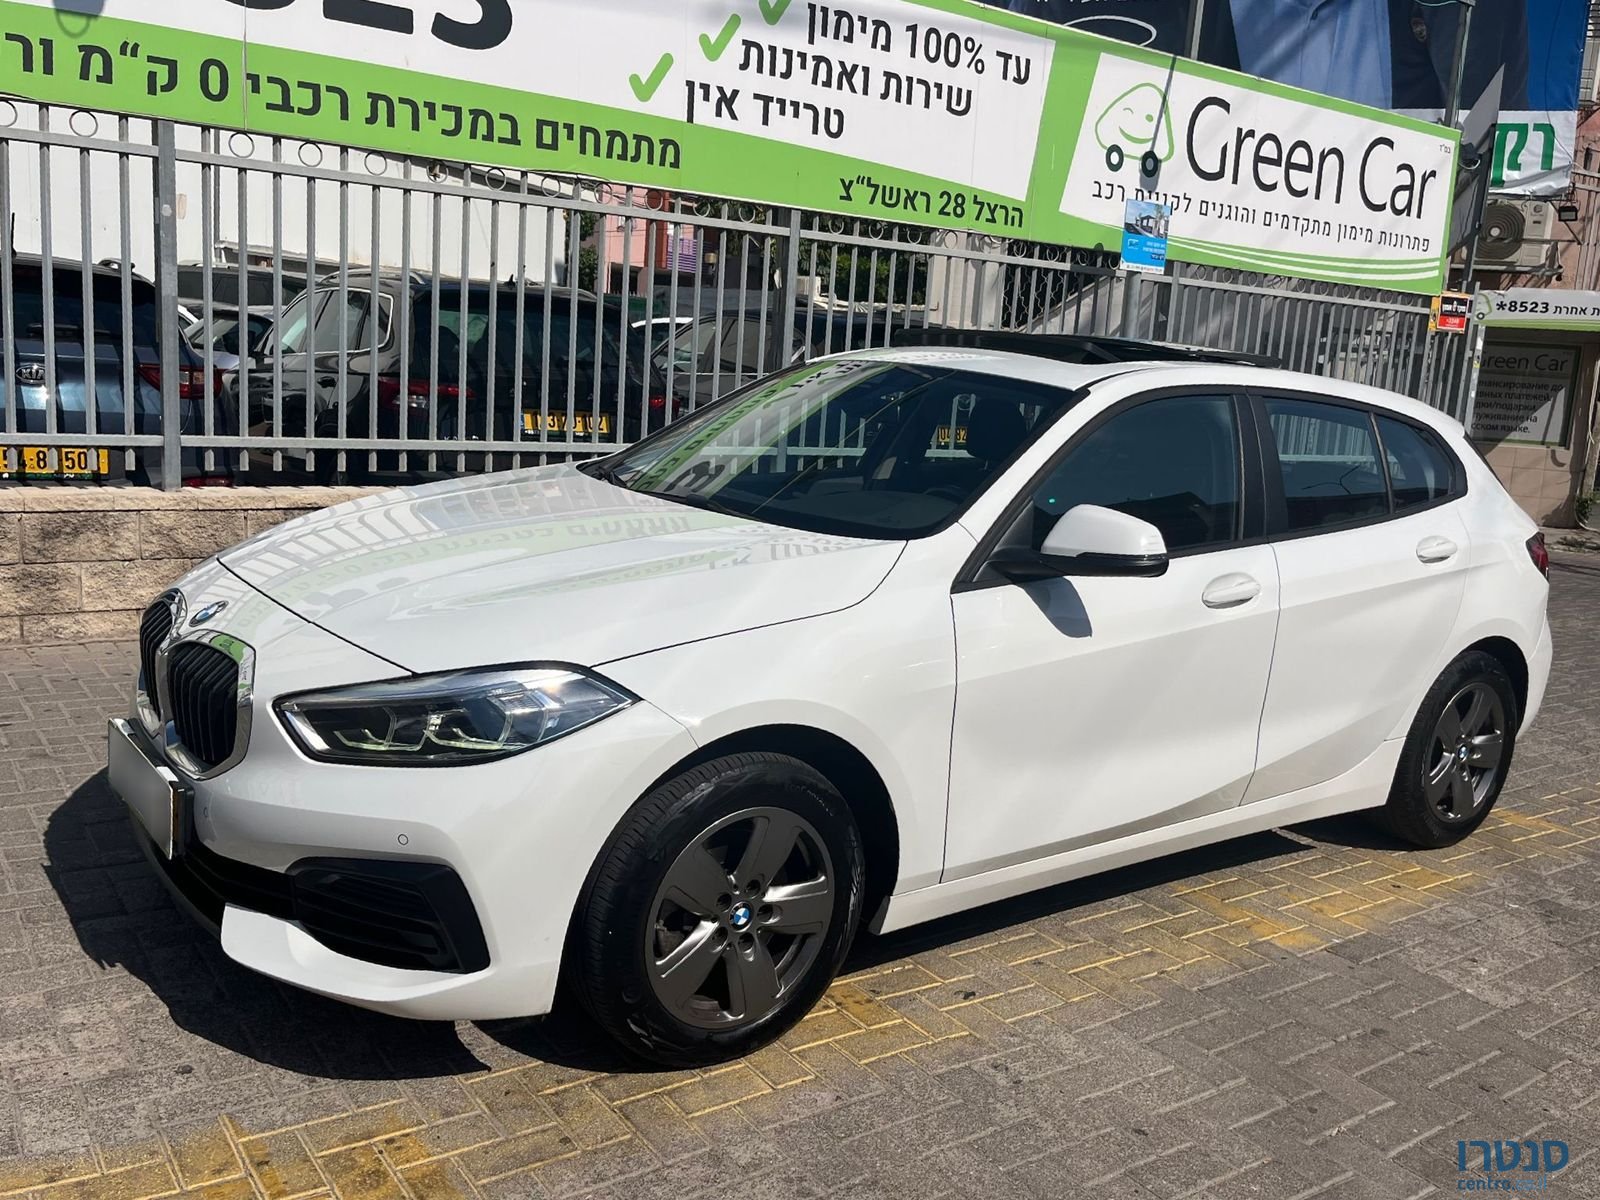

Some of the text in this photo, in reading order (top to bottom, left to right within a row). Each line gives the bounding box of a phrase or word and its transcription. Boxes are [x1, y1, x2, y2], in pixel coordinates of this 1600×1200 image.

[807, 2, 1031, 86] עד 100% מימון
[199, 57, 230, 102] 0
[738, 38, 973, 117] שירות ואמינות
[246, 72, 350, 121] רכבי
[686, 79, 845, 139] טרייד אין
[365, 91, 521, 146] במכירת
[535, 117, 681, 169] מתמחים
[1186, 95, 1437, 220] Green Car
[939, 190, 967, 220] 28
[1092, 181, 1126, 202] רכב
[974, 197, 1024, 228] הרצל
[1199, 200, 1257, 224] והוגנים
[1263, 211, 1332, 237] מתקדמים
[1337, 224, 1374, 243] מימון
[1378, 231, 1430, 252] פתרונות
[1553, 305, 1588, 315] אחרת
[1534, 354, 1568, 371] Car
[1551, 384, 1564, 392] до
